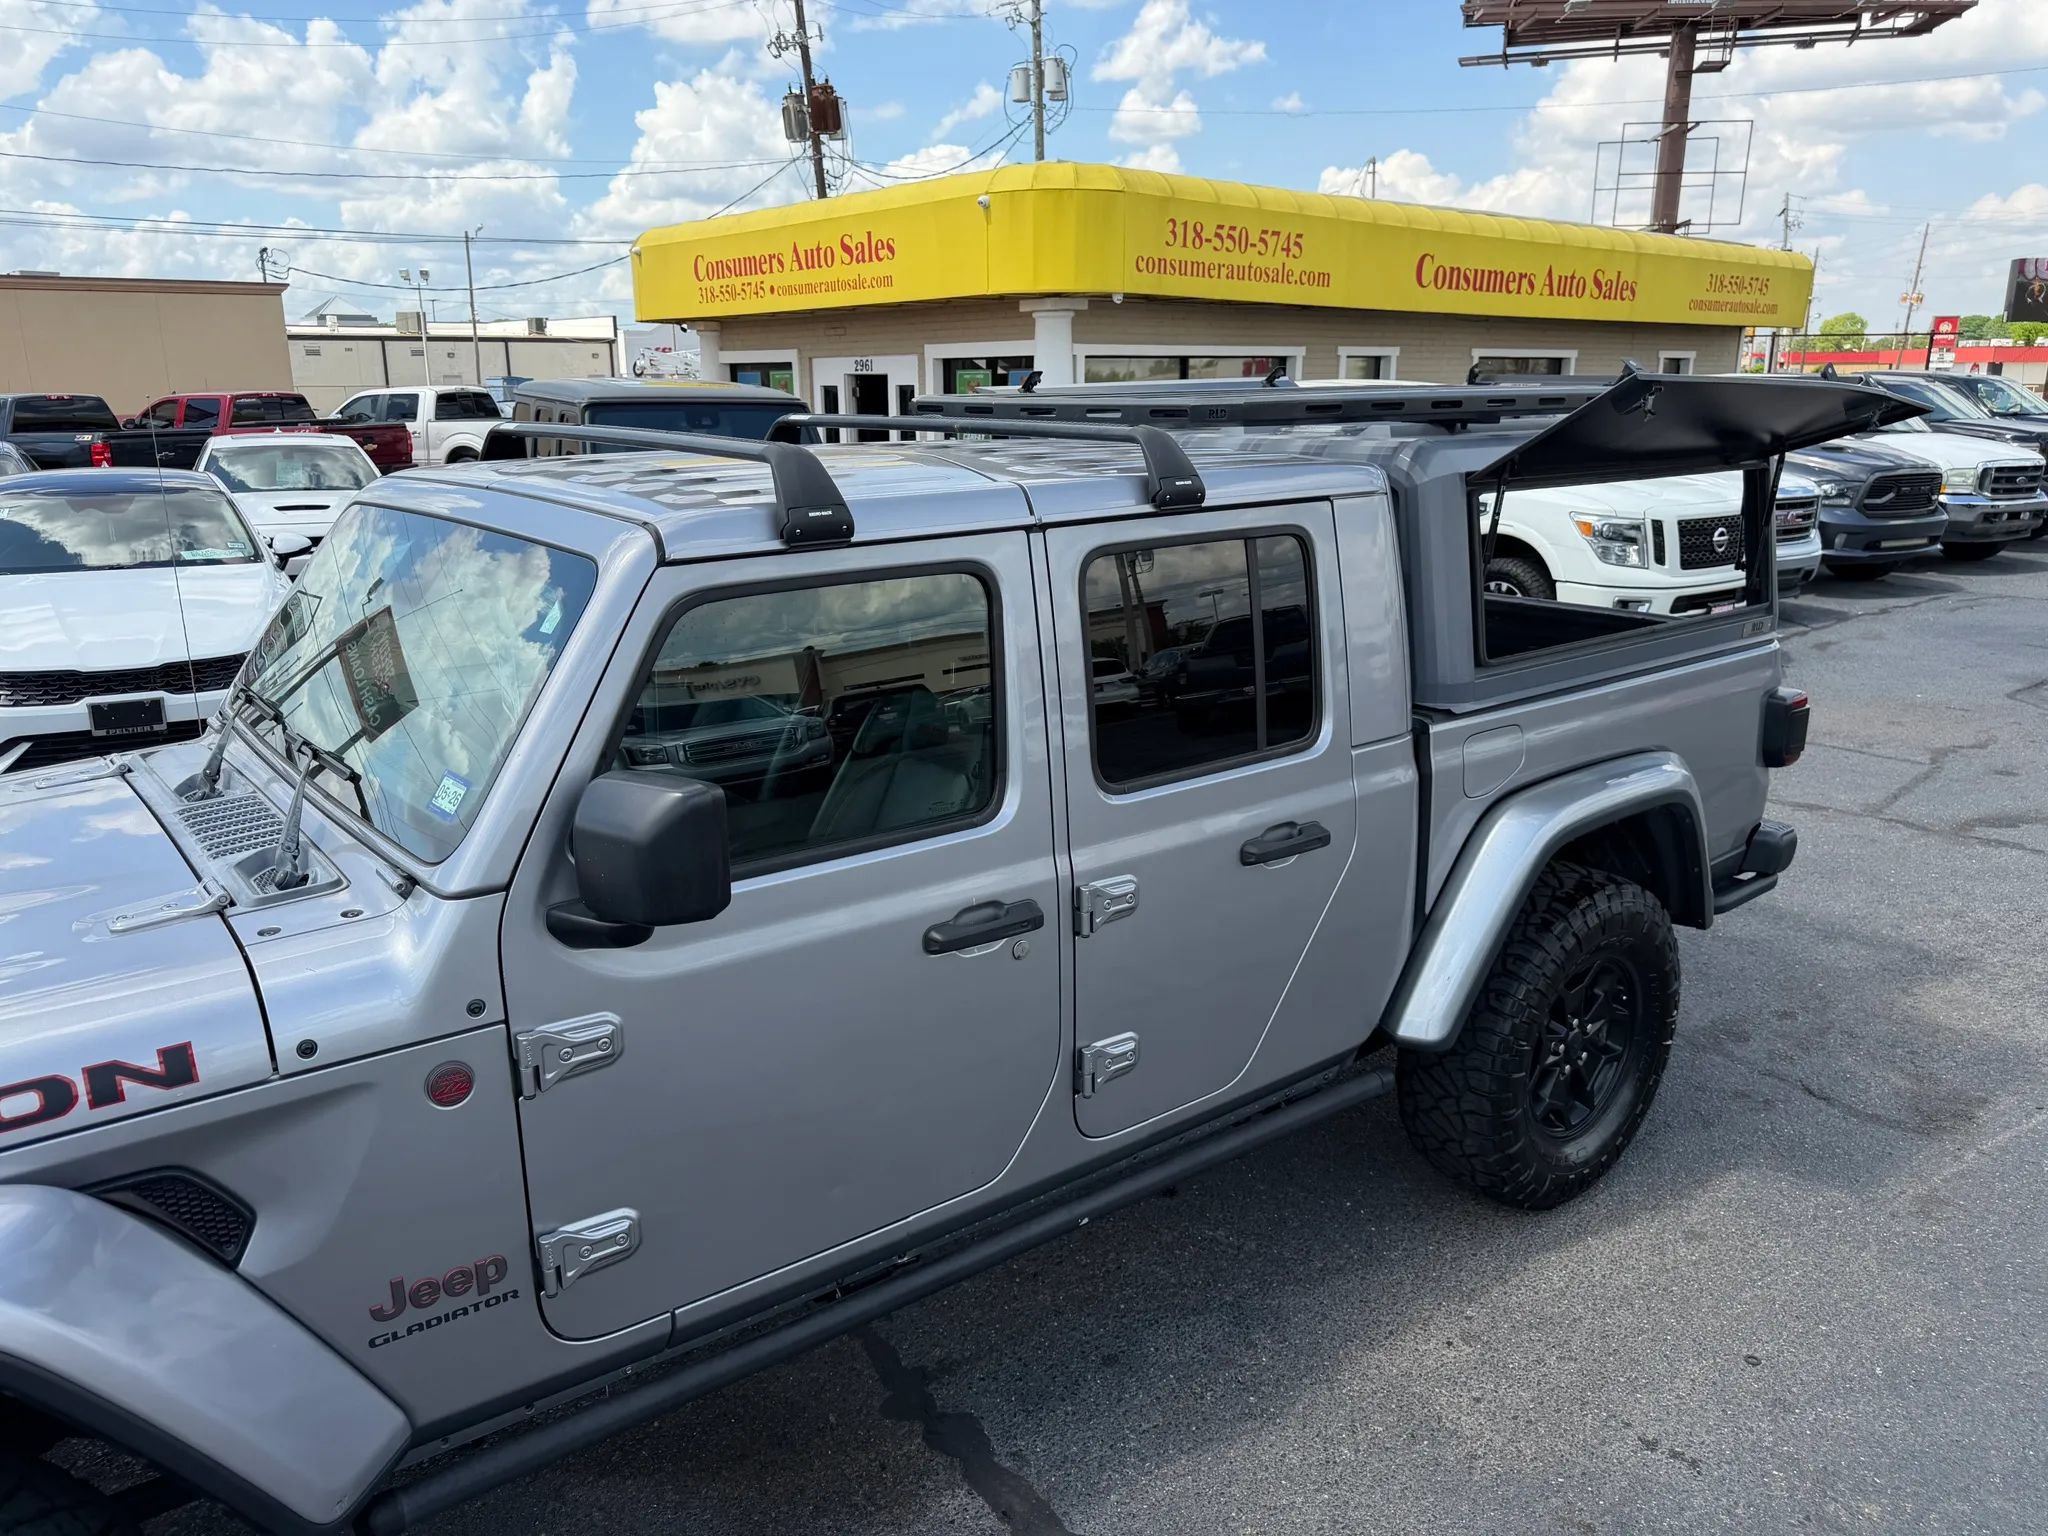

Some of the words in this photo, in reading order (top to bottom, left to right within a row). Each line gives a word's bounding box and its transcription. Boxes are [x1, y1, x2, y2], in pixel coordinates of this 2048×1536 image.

[1165, 217, 1304, 259] 318-550-5745
[693, 251, 785, 283] Consumers
[789, 239, 835, 272] Auto
[839, 230, 896, 266] Sales
[1135, 253, 1331, 288] consumerautosale.com
[698, 280, 766, 304] 318-550-5745
[776, 273, 893, 297] consumerautosale.com
[1415, 252, 1537, 296] Consumers
[1539, 263, 1587, 299] Auto
[1590, 268, 1638, 302] Sales
[1705, 273, 1770, 296] 318-550-5745
[1688, 298, 1778, 315] consumerautosale.com
[854, 358, 873, 372] 2961
[109, 725, 152, 736] PELTIER
[368, 1254, 509, 1323] Jeep
[367, 1288, 520, 1349] GLADIATOR
